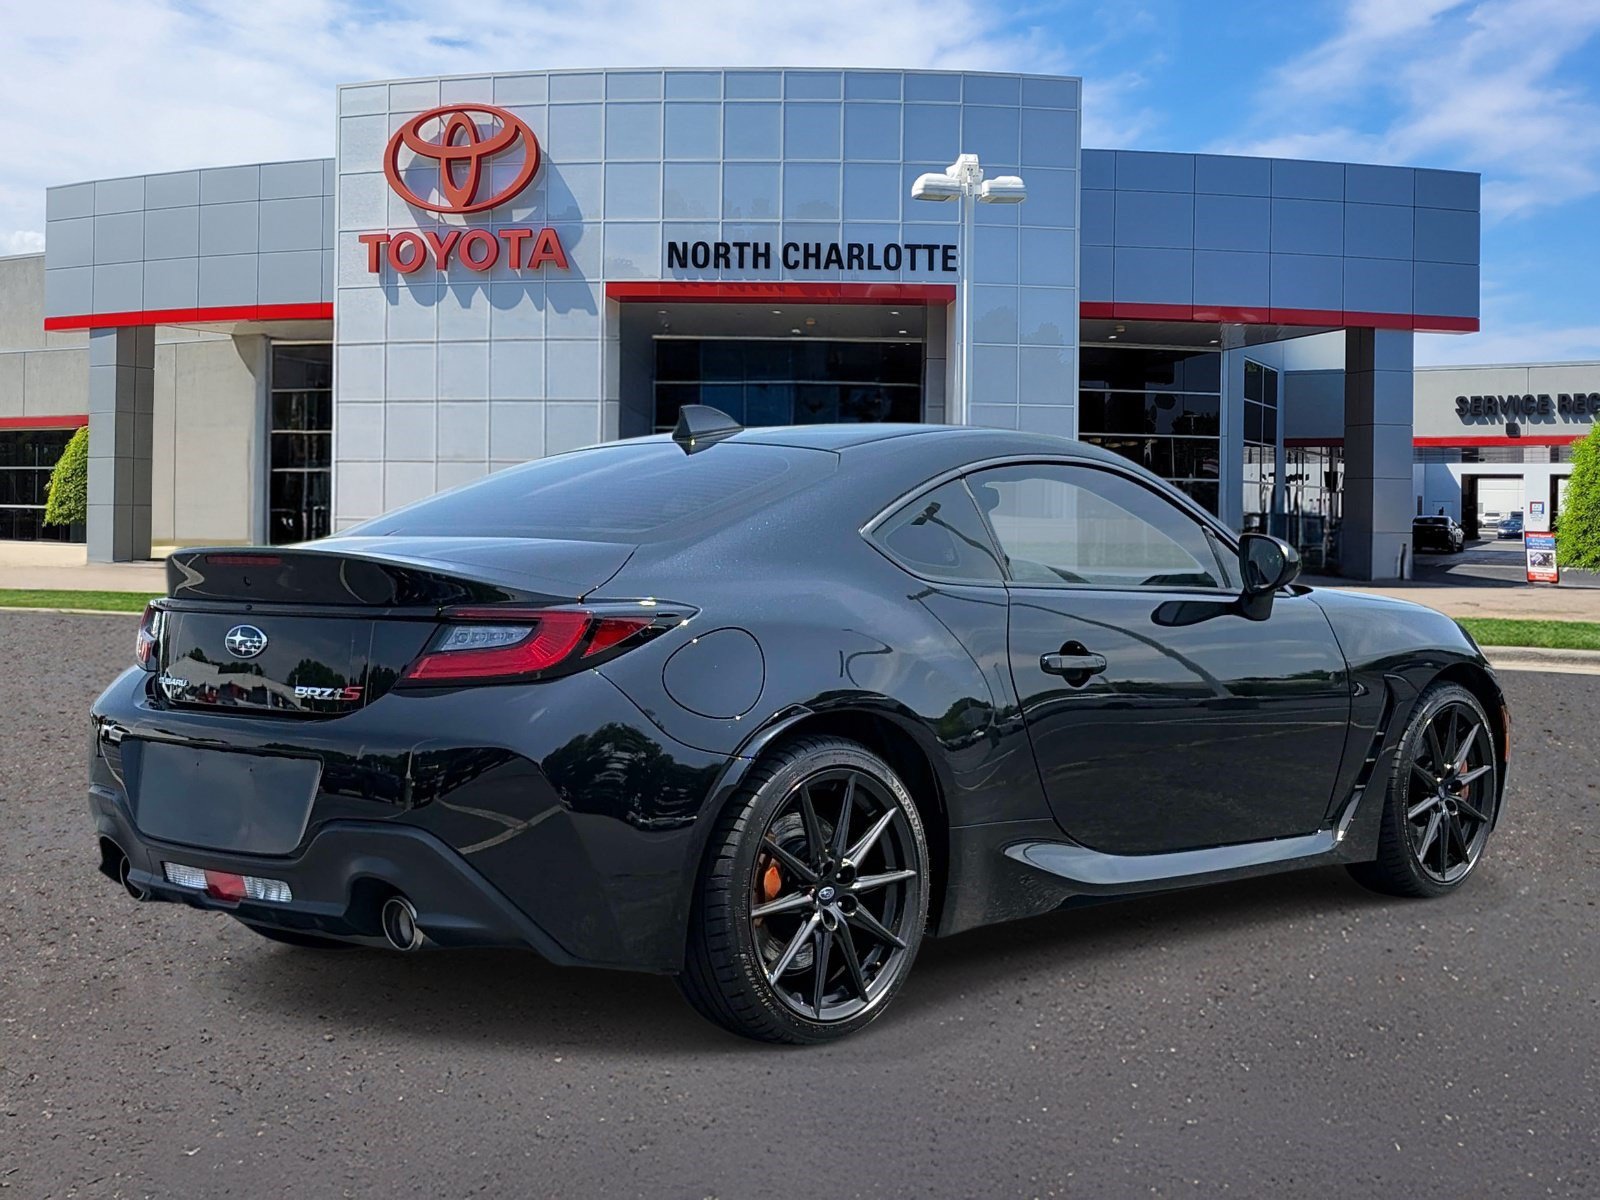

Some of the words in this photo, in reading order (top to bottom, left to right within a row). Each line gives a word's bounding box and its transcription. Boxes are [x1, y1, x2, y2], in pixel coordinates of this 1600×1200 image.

[359, 228, 569, 274] TOYOTA
[667, 241, 771, 269] NORTH
[782, 242, 957, 272] CHARLOTTE
[1455, 394, 1551, 416] SERVICE
[159, 676, 188, 687] SUBARU
